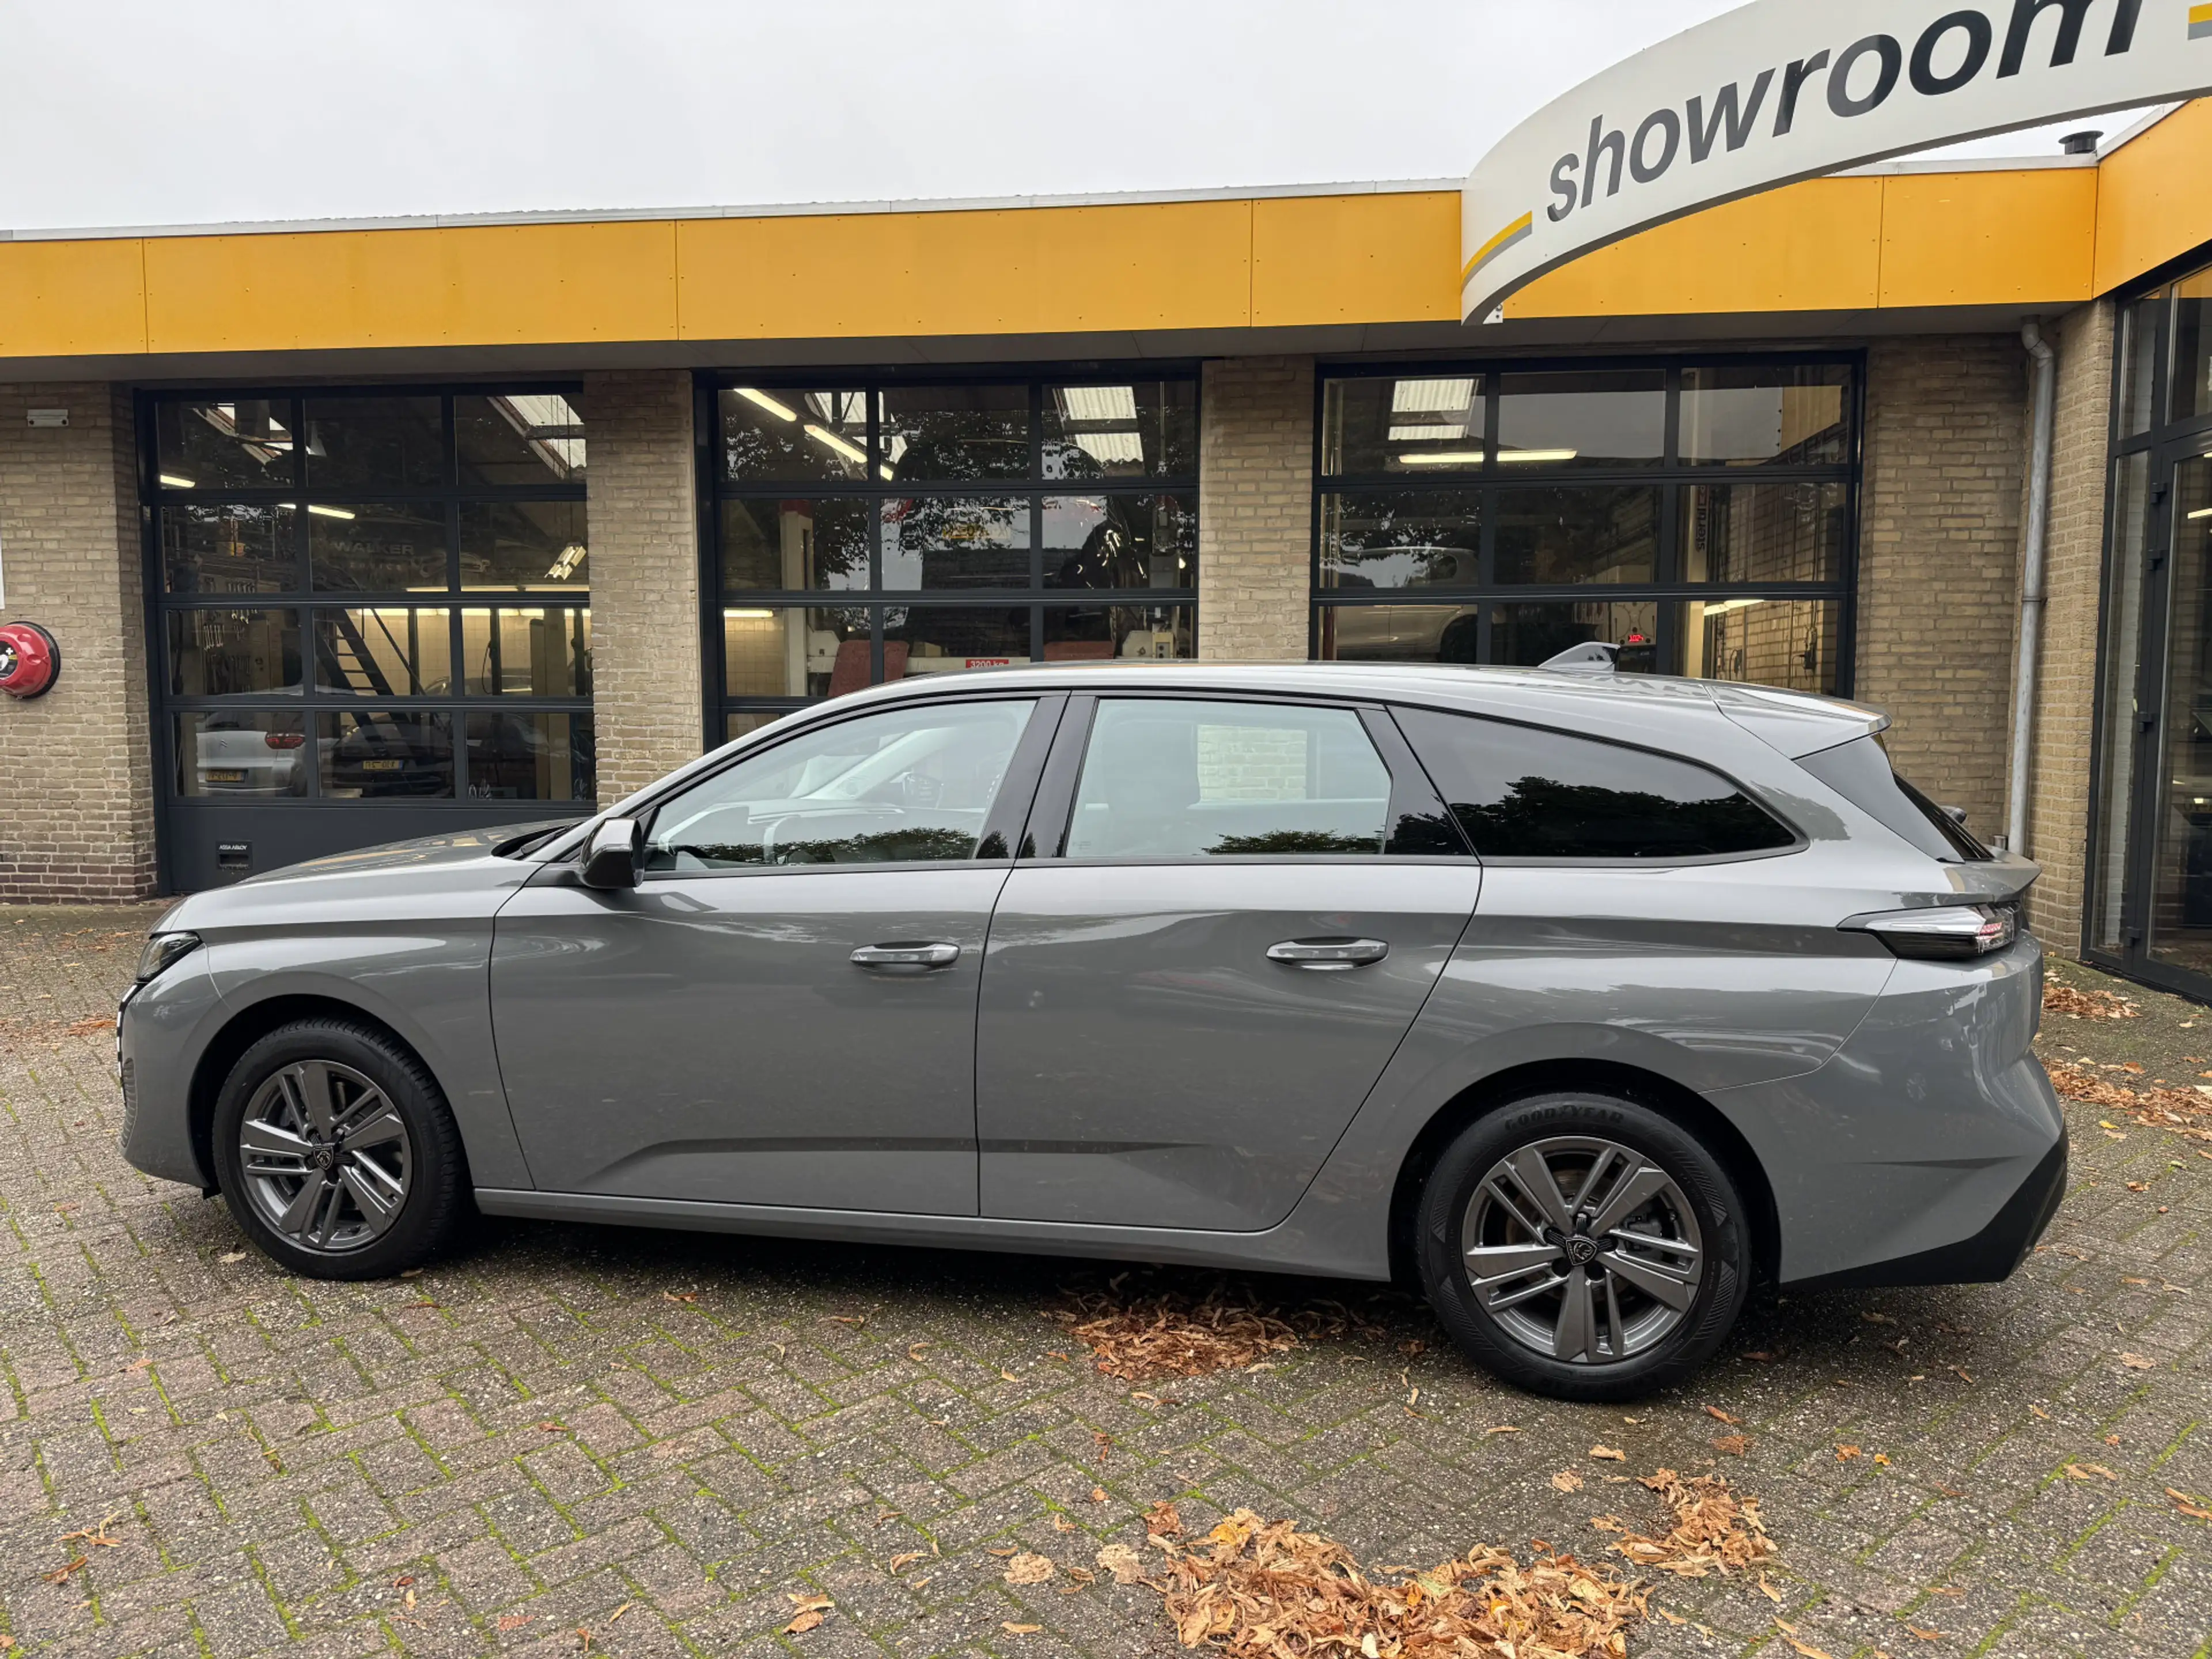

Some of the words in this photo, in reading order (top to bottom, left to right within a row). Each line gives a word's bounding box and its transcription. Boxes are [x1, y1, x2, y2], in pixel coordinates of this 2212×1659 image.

[1547, 0, 2143, 222] showroom
[330, 541, 415, 555] WALKER
[971, 660, 991, 668] 3200
[1504, 1104, 1624, 1131] GOODYEAR
